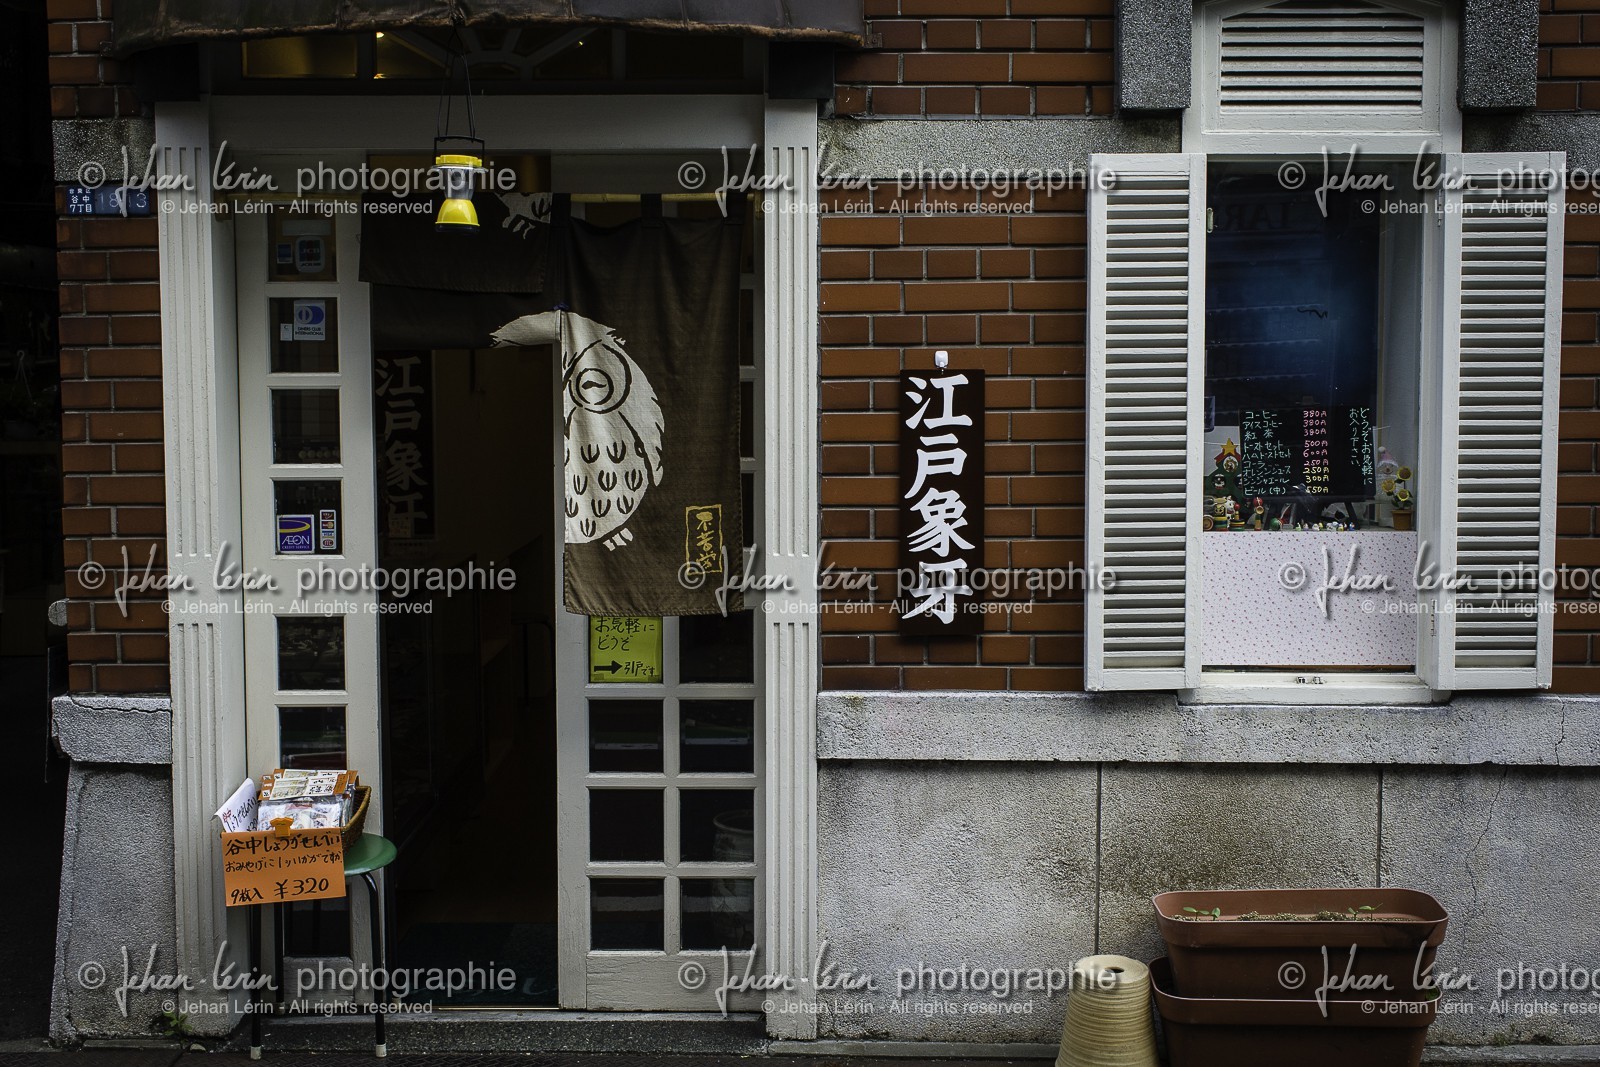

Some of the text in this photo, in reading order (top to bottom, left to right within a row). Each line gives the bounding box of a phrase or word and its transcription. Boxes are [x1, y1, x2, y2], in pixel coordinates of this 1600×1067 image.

[71, 195, 90, 204] 谷中
[69, 204, 92, 213] 7丁目
[1245, 409, 1327, 420] コーヒー 380円
[1242, 419, 1327, 430] アイスコーヒー 380円
[1303, 428, 1327, 437] 380円
[1304, 440, 1329, 448] 500円
[1361, 407, 1374, 486] どうぞお気軽に
[1303, 466, 1330, 474] 250円
[902, 374, 976, 625] 江戸象牙
[595, 616, 655, 634] お気軽に
[598, 634, 634, 651] どうぞ
[624, 661, 656, 677] 引戸です
[225, 830, 341, 856] 谷中しょうがせんべい
[230, 887, 264, 905] 9枚入
